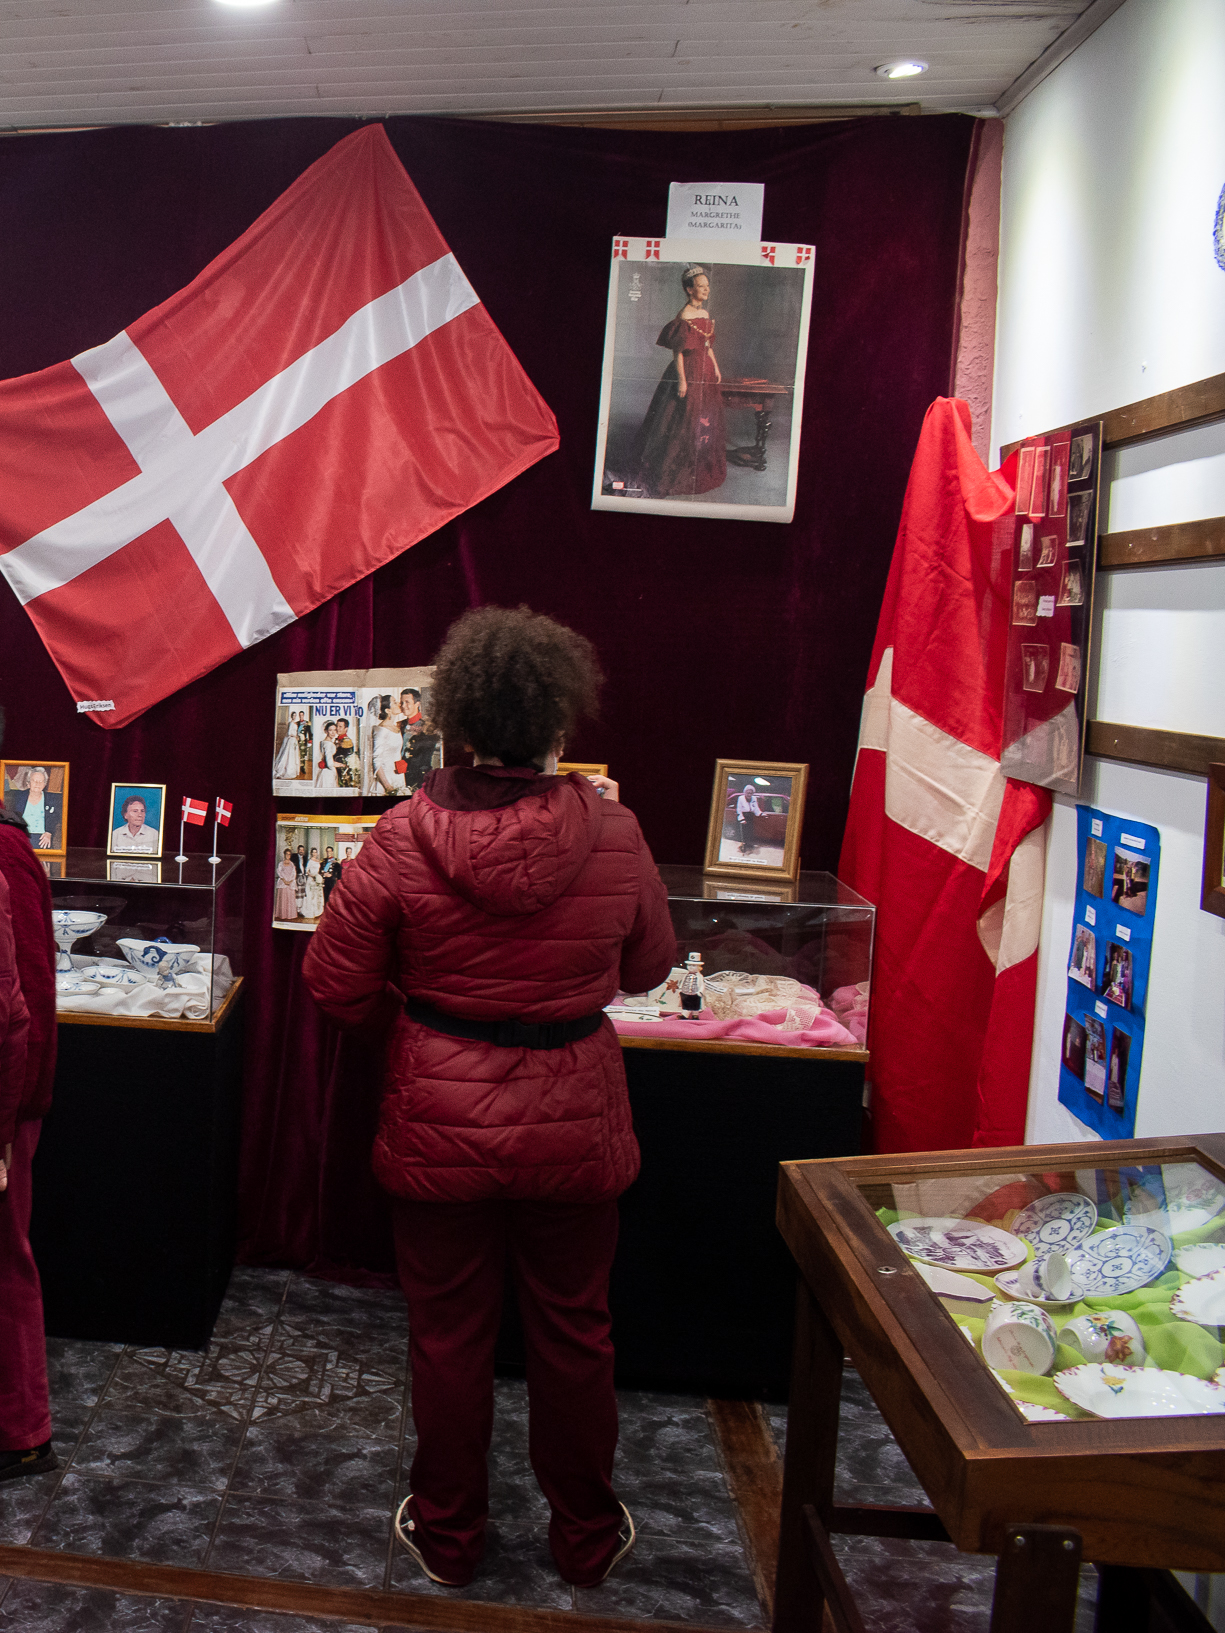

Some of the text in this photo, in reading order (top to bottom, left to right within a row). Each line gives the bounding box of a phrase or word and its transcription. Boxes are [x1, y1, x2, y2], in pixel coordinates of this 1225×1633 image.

[694, 194, 739, 207] REINA
[690, 211, 741, 220] MARGRETHE
[687, 221, 743, 230] (MARGARITA)
[314, 705, 328, 716] NU
[329, 705, 341, 717] ER
[343, 705, 352, 717] VI
